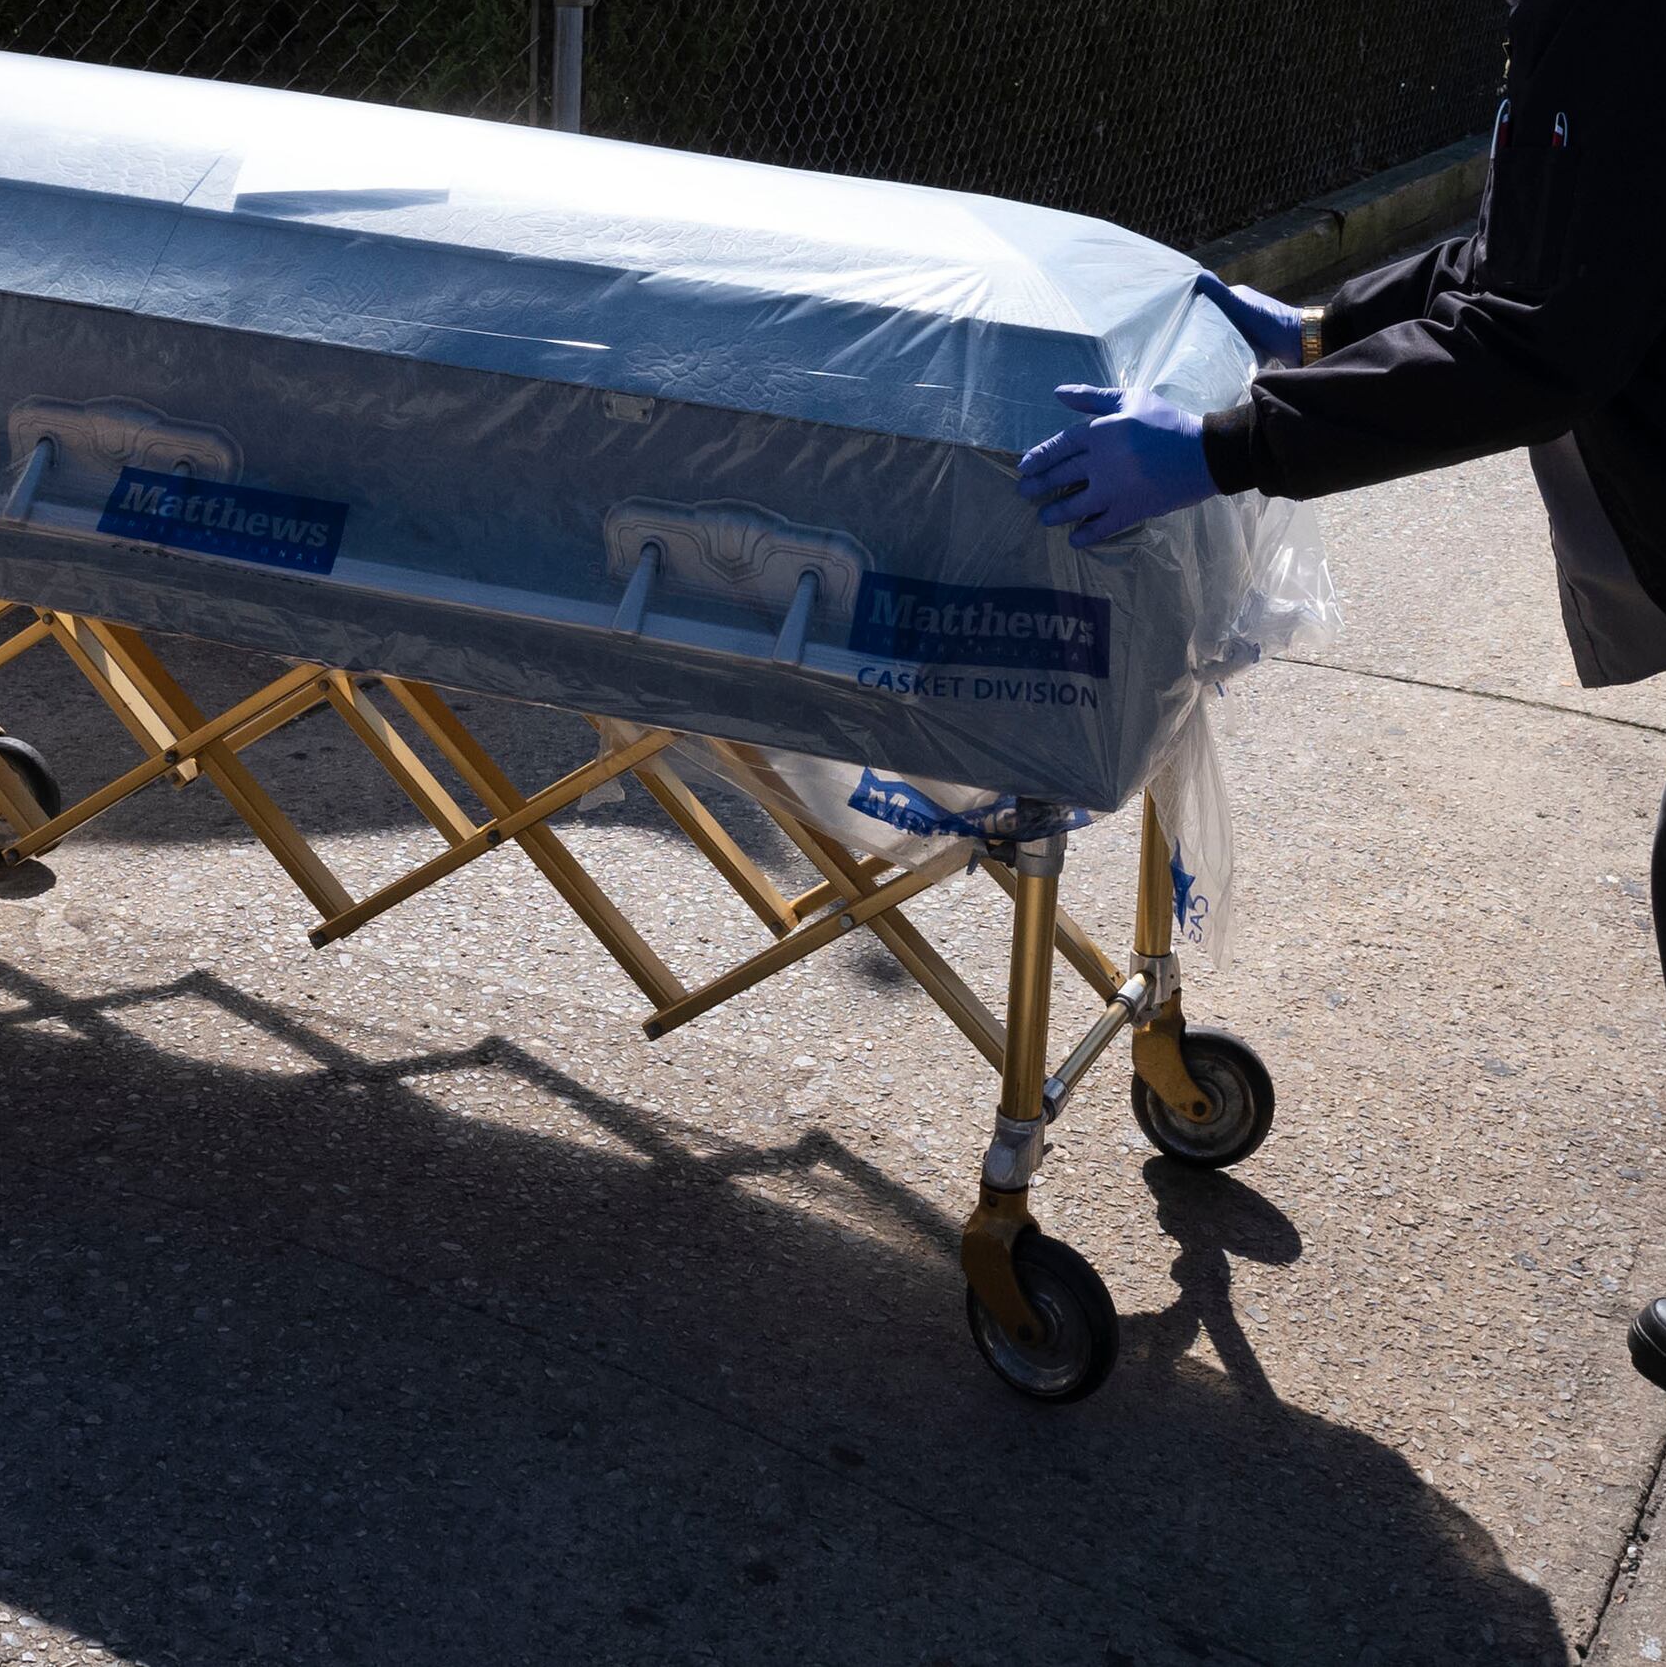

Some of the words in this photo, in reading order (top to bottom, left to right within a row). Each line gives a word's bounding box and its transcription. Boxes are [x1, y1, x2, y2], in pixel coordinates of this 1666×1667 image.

[118, 481, 331, 549] Matthews
[868, 588, 1096, 647] Matthews
[857, 667, 964, 699] CASKET
[974, 677, 1099, 710] DIVISION
